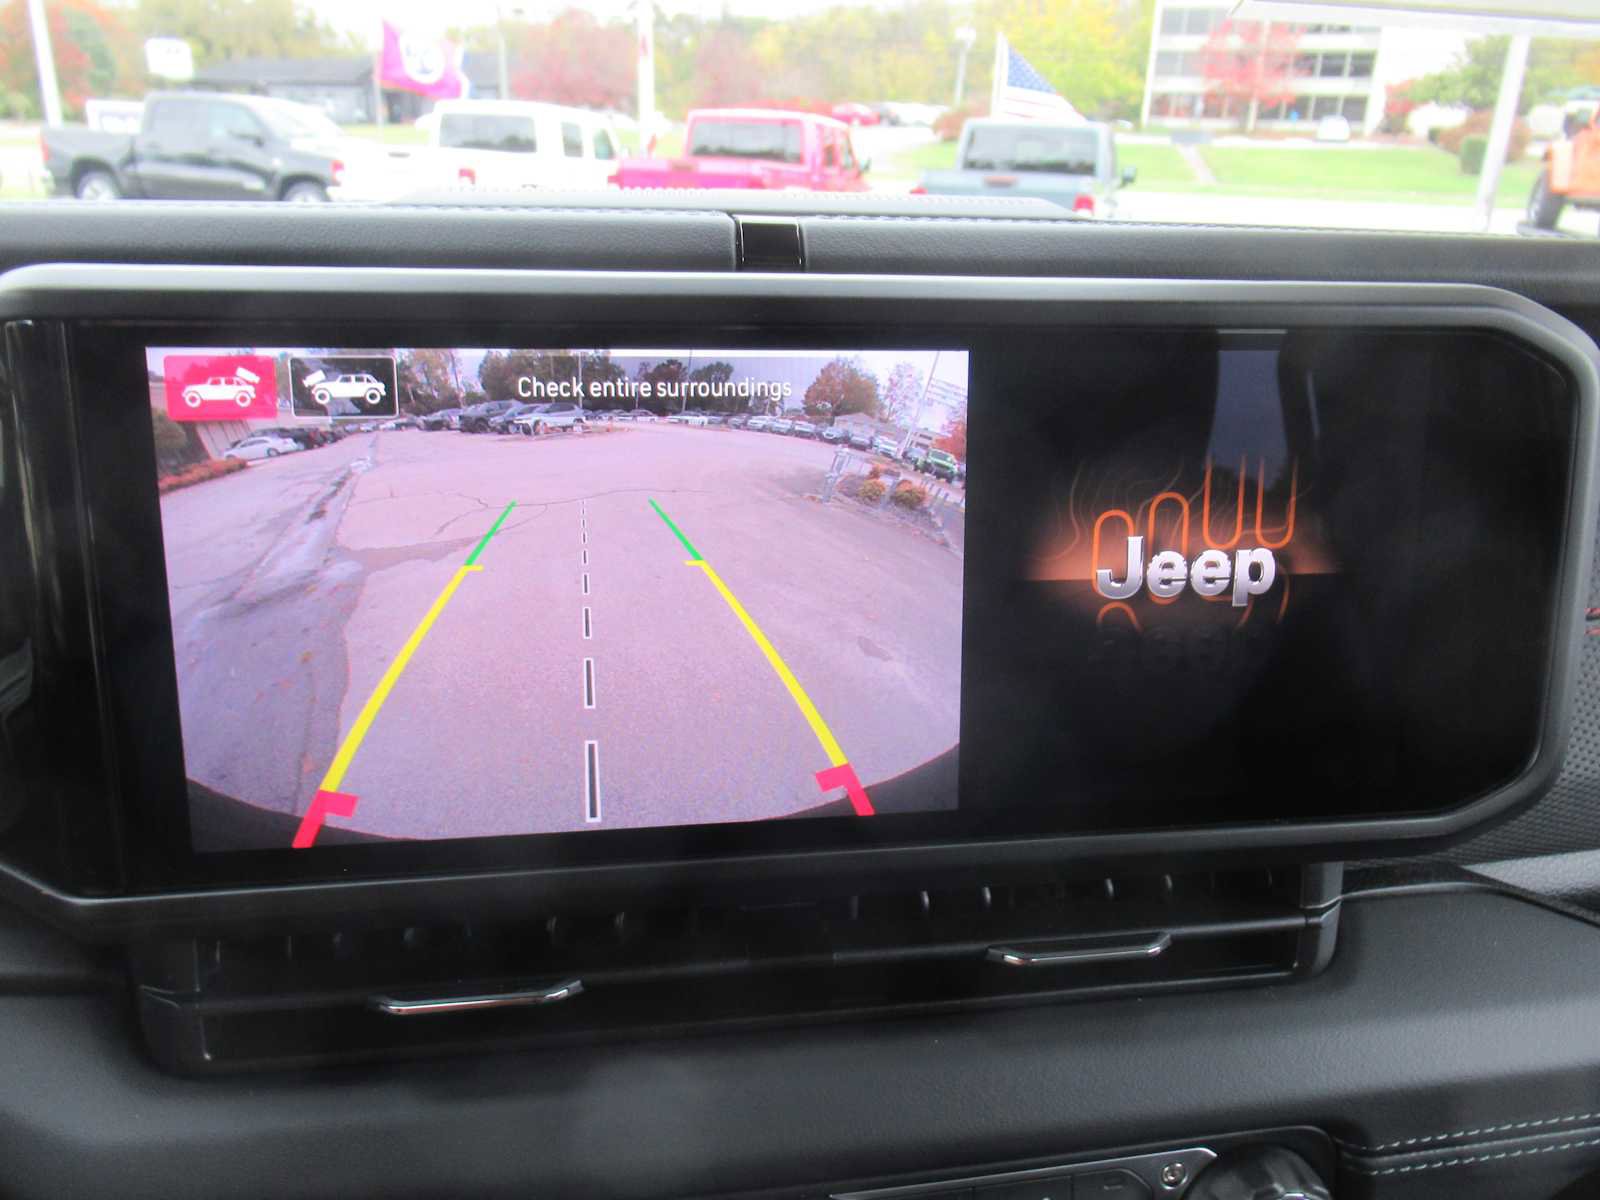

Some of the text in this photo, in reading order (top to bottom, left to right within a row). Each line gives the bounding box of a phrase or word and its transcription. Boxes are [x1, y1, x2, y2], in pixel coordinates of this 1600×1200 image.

[517, 376, 792, 400] Check entire surroundings
[1095, 535, 1276, 607] Jeep
